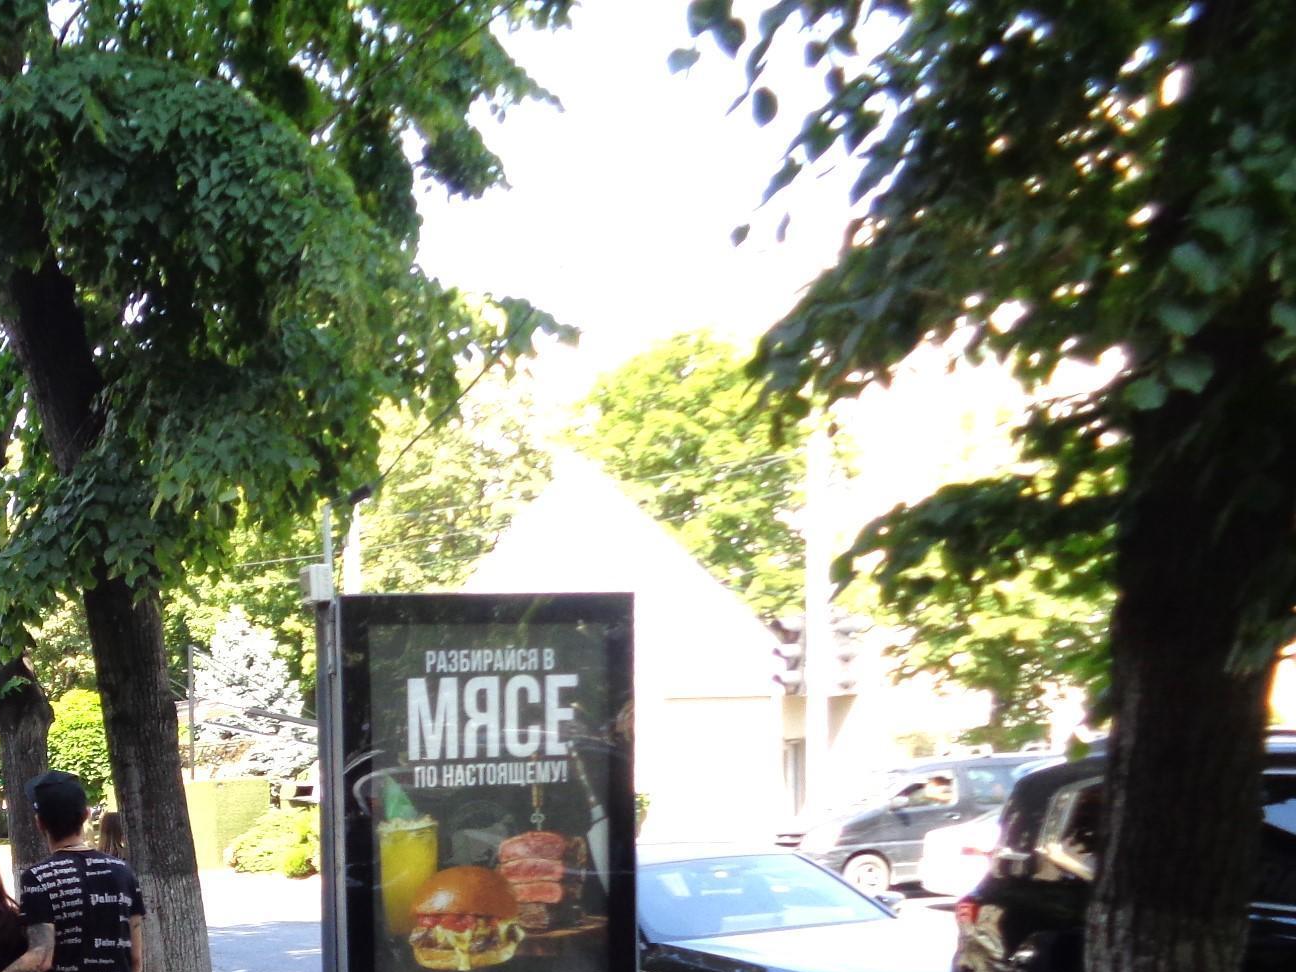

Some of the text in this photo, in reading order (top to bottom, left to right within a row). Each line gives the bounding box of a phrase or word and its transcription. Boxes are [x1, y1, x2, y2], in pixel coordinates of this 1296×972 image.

[425, 645, 555, 673] РАЗБИРАЙСЯ В
[407, 673, 579, 761] МЯСЕ
[414, 760, 568, 788] ПО НАСТОЯЩЕМУ!
